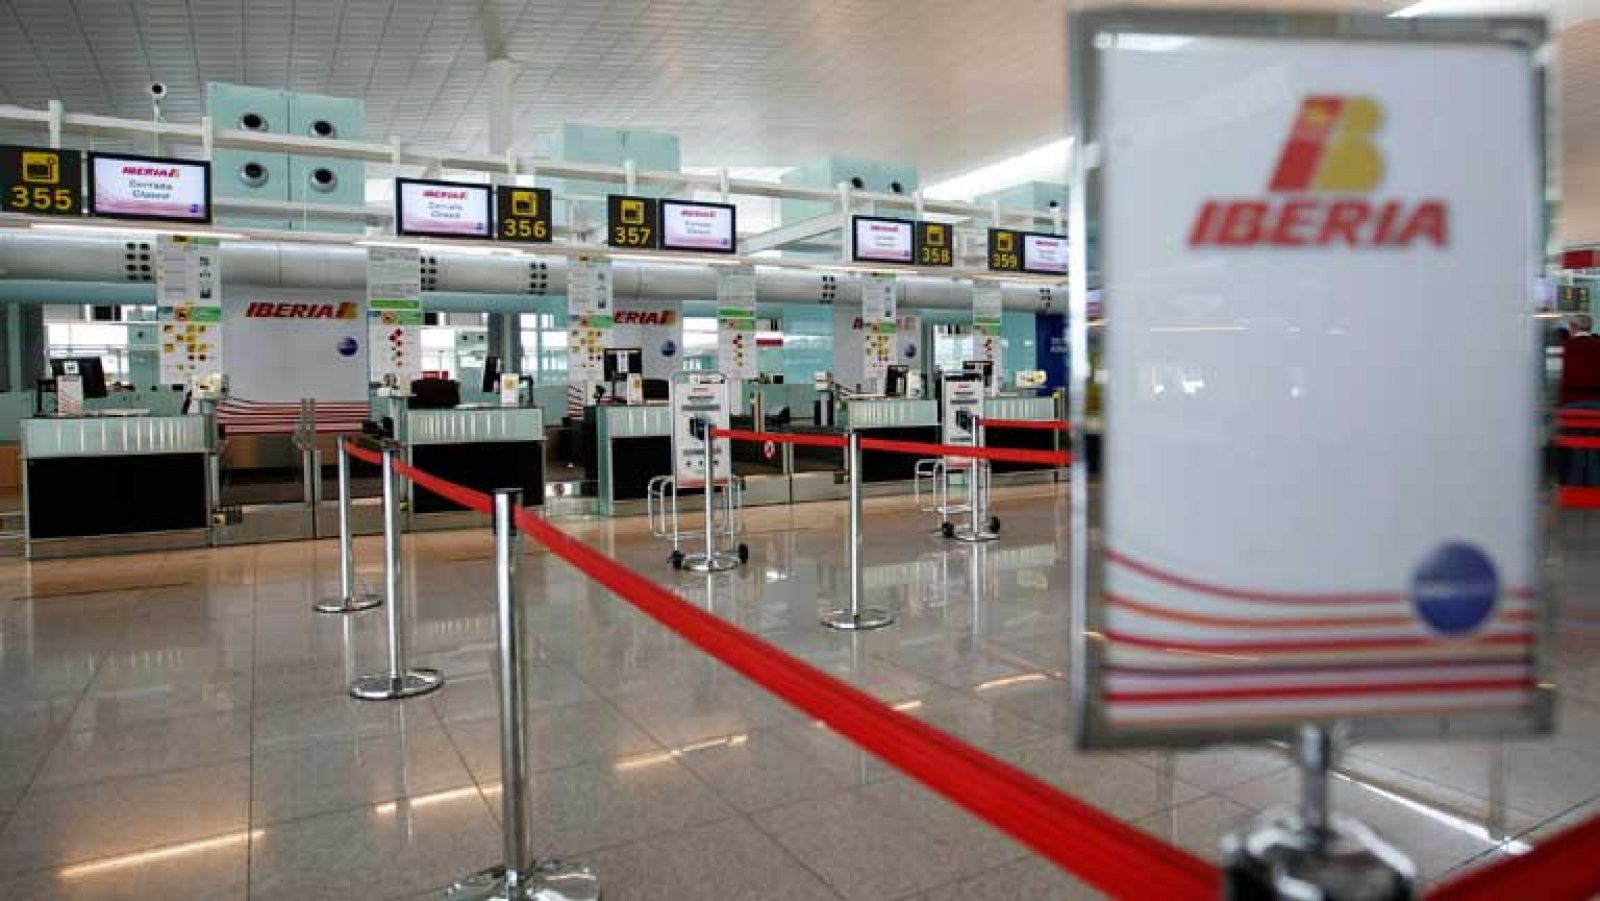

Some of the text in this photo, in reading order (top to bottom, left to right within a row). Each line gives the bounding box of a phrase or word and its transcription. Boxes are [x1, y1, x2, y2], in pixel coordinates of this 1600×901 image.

[11, 186, 72, 210] 355
[504, 218, 546, 239] 356
[1188, 199, 1451, 248] IBERIA
[616, 226, 650, 245] 357
[923, 247, 949, 264] 358
[993, 253, 1017, 268] 359
[246, 301, 335, 318] IBERIA
[614, 310, 660, 325] ERIA
